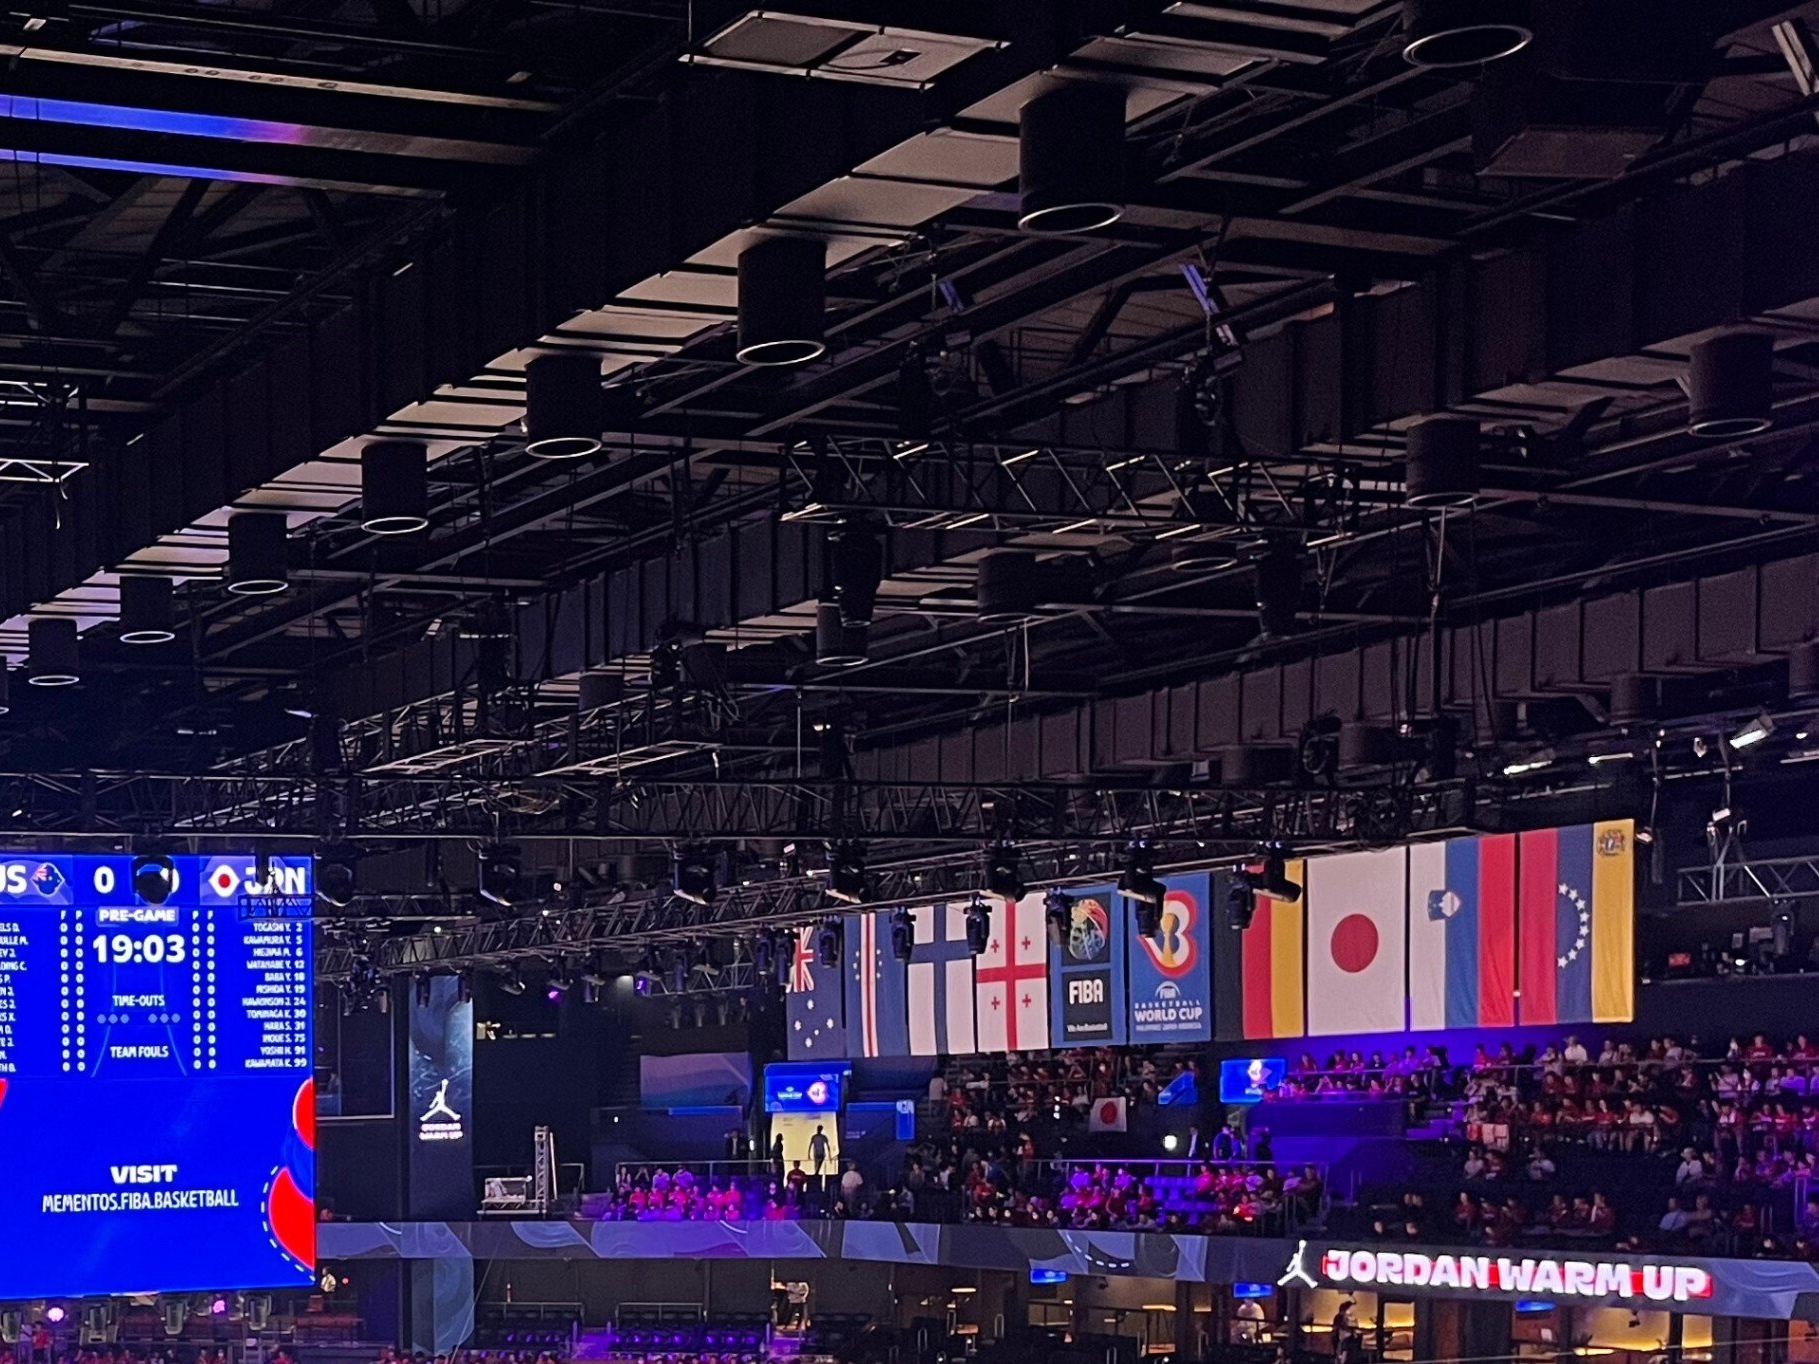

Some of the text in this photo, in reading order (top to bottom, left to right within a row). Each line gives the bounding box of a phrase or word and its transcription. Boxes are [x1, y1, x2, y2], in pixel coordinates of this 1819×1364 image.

[93, 866, 115, 894] 0
[99, 909, 176, 922] PRE-GAME
[93, 934, 186, 963] 19:03
[112, 995, 166, 1006] TIME-OUTS
[1069, 979, 1103, 1005] FIBA
[1134, 1000, 1201, 1009] BASKETBALL
[1134, 1007, 1203, 1022] WORLD CUP
[110, 1046, 169, 1058] TEAM FOULS
[110, 1164, 178, 1184] VISIT
[42, 1188, 239, 1213] MEMENTOS.FIBA.BASKETBALL
[1326, 1249, 1710, 1301] JORDAN WARM UP
